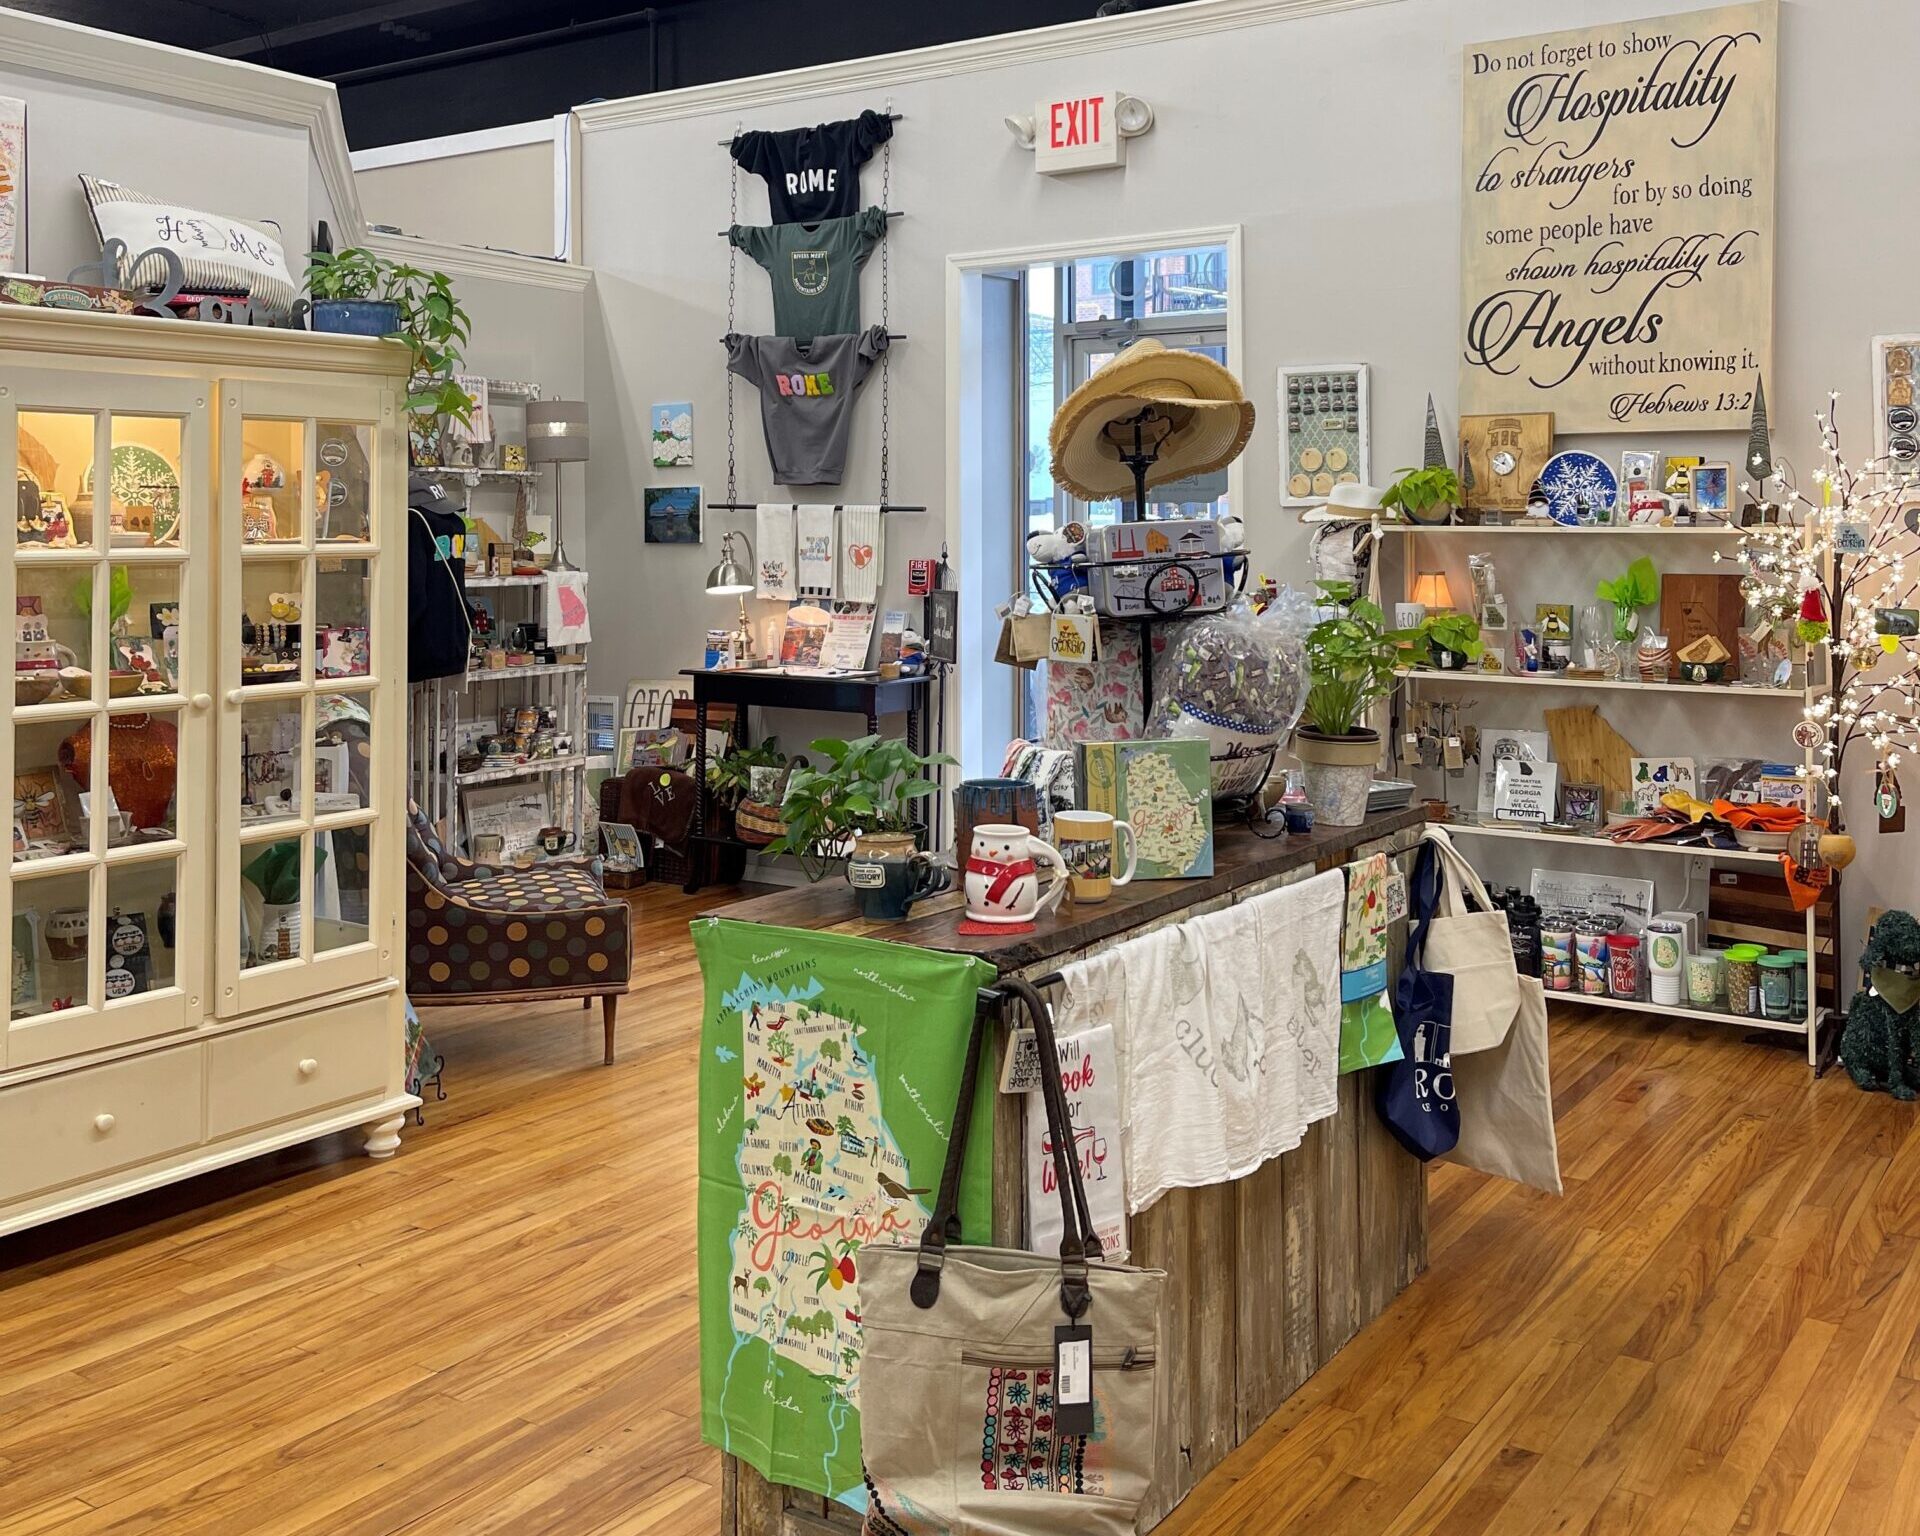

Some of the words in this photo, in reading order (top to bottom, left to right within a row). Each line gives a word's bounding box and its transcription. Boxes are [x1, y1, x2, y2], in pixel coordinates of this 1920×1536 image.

[1473, 53, 1501, 75] Do
[1506, 51, 1534, 70] not
[1540, 44, 1595, 67] forget
[1599, 40, 1616, 58] to
[1622, 33, 1672, 55] show
[1504, 32, 1761, 159] Hospitality
[1050, 97, 1104, 148] EXIT
[786, 168, 837, 196] ROME
[1475, 146, 1519, 192] to
[1510, 141, 1635, 209] strangers
[1613, 182, 1640, 205] for
[1645, 181, 1666, 206] by
[1672, 183, 1692, 200] so
[1698, 176, 1753, 199] doing
[1485, 226, 1533, 246] some
[1539, 215, 1603, 247] people
[1609, 213, 1653, 236] have
[1506, 247, 1576, 282] shown
[1584, 233, 1724, 294] hospitality
[1717, 230, 1760, 266] to
[1464, 270, 1702, 388] Angels
[1588, 355, 1656, 376] without
[1659, 351, 1737, 375] knowing
[1741, 349, 1760, 370] it.
[776, 372, 834, 398] ROME
[1607, 383, 1709, 423] Hebrews
[1714, 391, 1753, 413] 13:2
[910, 560, 928, 569] FIRE
[1051, 636, 1086, 655] GEORGIA
[1132, 803, 1195, 839] Georgia
[1509, 809, 1540, 817] HOME
[1616, 970, 1628, 978] MY
[716, 980, 764, 1026] APPALACHIAN
[766, 958, 817, 984] MOUNTAINS
[747, 1031, 760, 1046] ROME
[1059, 1040, 1080, 1065] Will
[757, 1056, 783, 1081] MARIETTA
[816, 1060, 845, 1086] GAINESVILLE
[1062, 1053, 1095, 1093] ook
[776, 1086, 826, 1126] ATLANTA
[844, 1098, 864, 1114] ATHENS
[1067, 1100, 1082, 1119] or
[751, 1137, 770, 1150] GRANGE
[740, 1164, 773, 1178] COLUMBUS
[881, 1150, 911, 1170] AUGUSTA
[793, 1169, 823, 1193] MACON
[752, 1180, 912, 1271] Georgia
[781, 1250, 810, 1267] CORDELE
[816, 1346, 842, 1365] VALDOSTA
